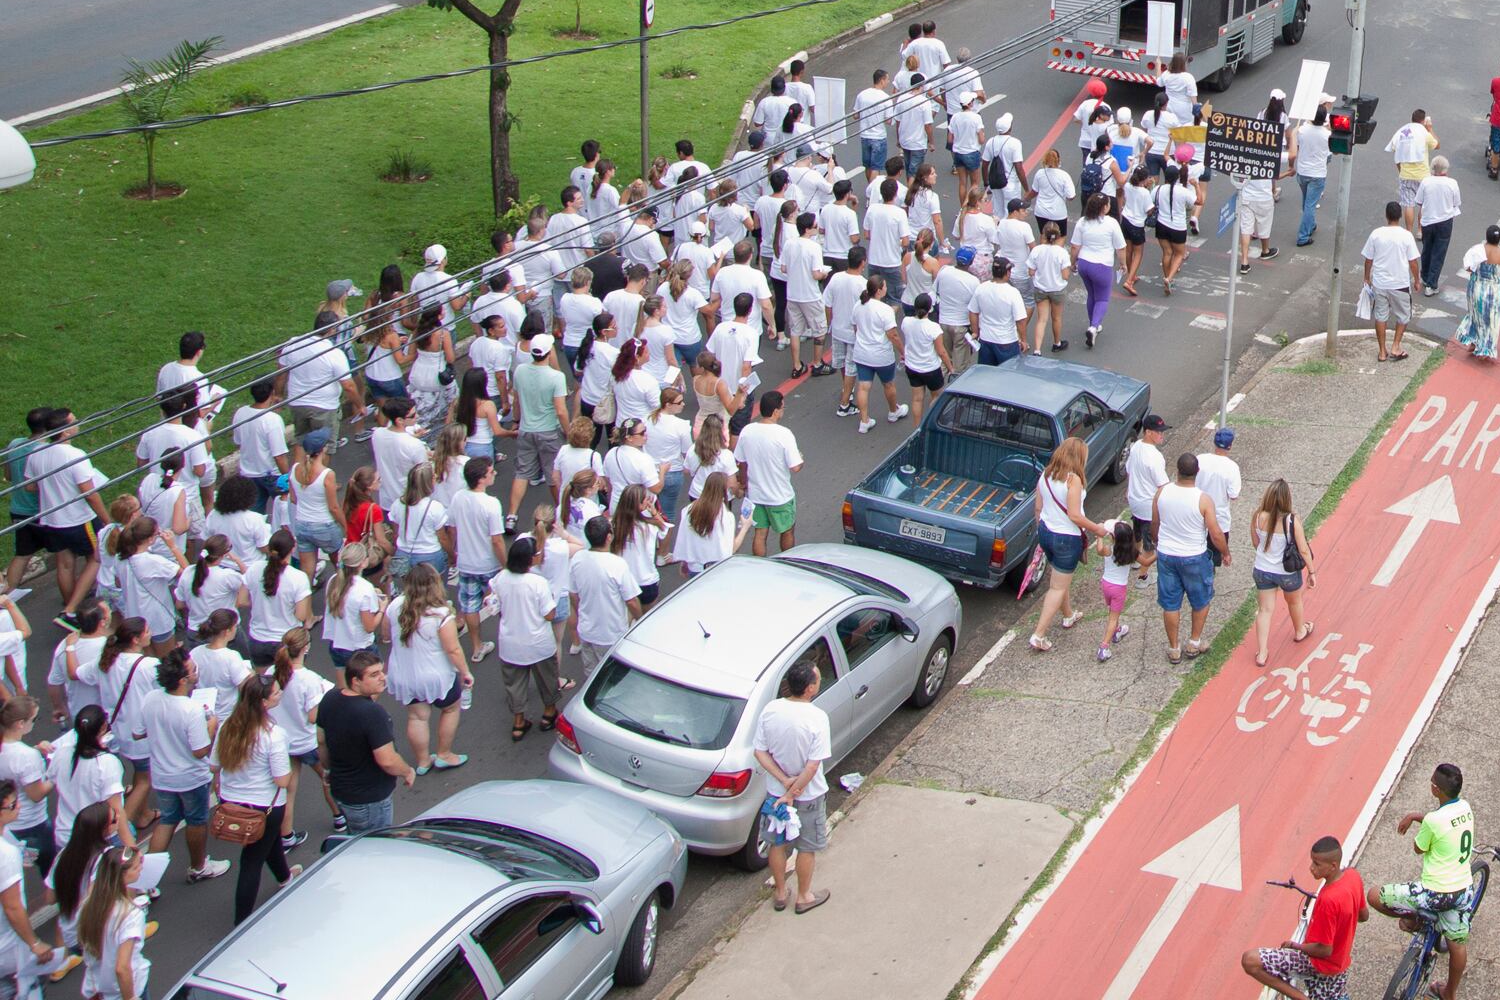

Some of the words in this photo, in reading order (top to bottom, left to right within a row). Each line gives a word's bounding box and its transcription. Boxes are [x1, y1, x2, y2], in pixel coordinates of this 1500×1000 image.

[1225, 127, 1277, 147] FABRIL
[1208, 141, 1239, 151] CORTINAS
[1245, 147, 1280, 158] PERSIANAS
[1210, 151, 1218, 159] R.
[1219, 152, 1237, 162] Paula
[1239, 156, 1262, 167] Bueno,
[1210, 159, 1274, 178] 2102.9800
[1459, 830, 1471, 864] 9
